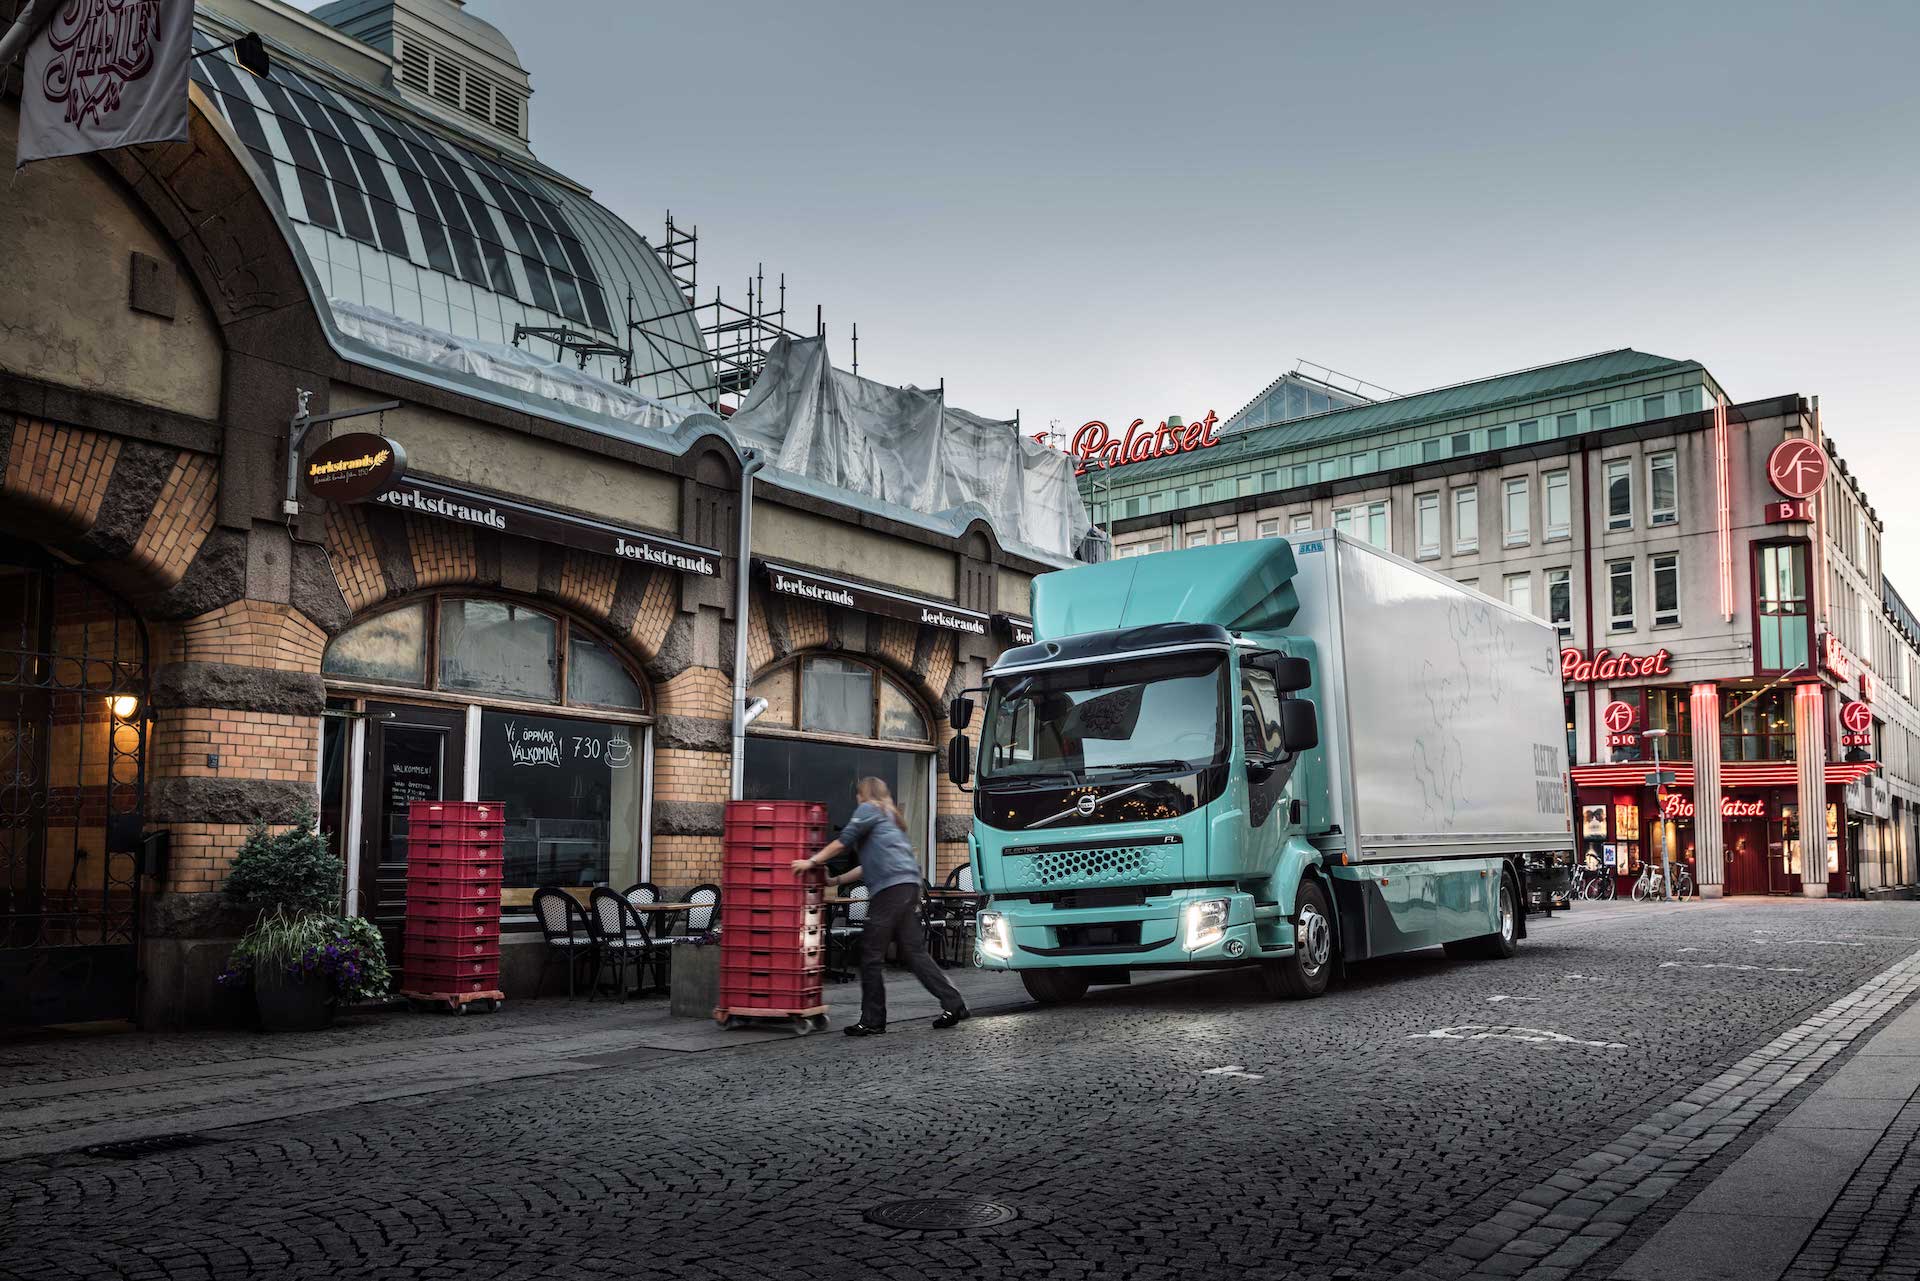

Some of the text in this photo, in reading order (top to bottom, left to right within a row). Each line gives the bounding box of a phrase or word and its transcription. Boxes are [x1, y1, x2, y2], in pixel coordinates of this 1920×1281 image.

[1072, 409, 1220, 477] Palatset
[309, 454, 374, 476] Jerkstrands
[1773, 445, 1823, 494] SF
[615, 538, 713, 576] Jerkstrands
[775, 575, 854, 607] Jerkstrands
[921, 608, 985, 634] Jerkstrands
[1561, 648, 1672, 682] Palatset
[572, 736, 601, 759] 730
[1664, 794, 1765, 816] Bio latset
